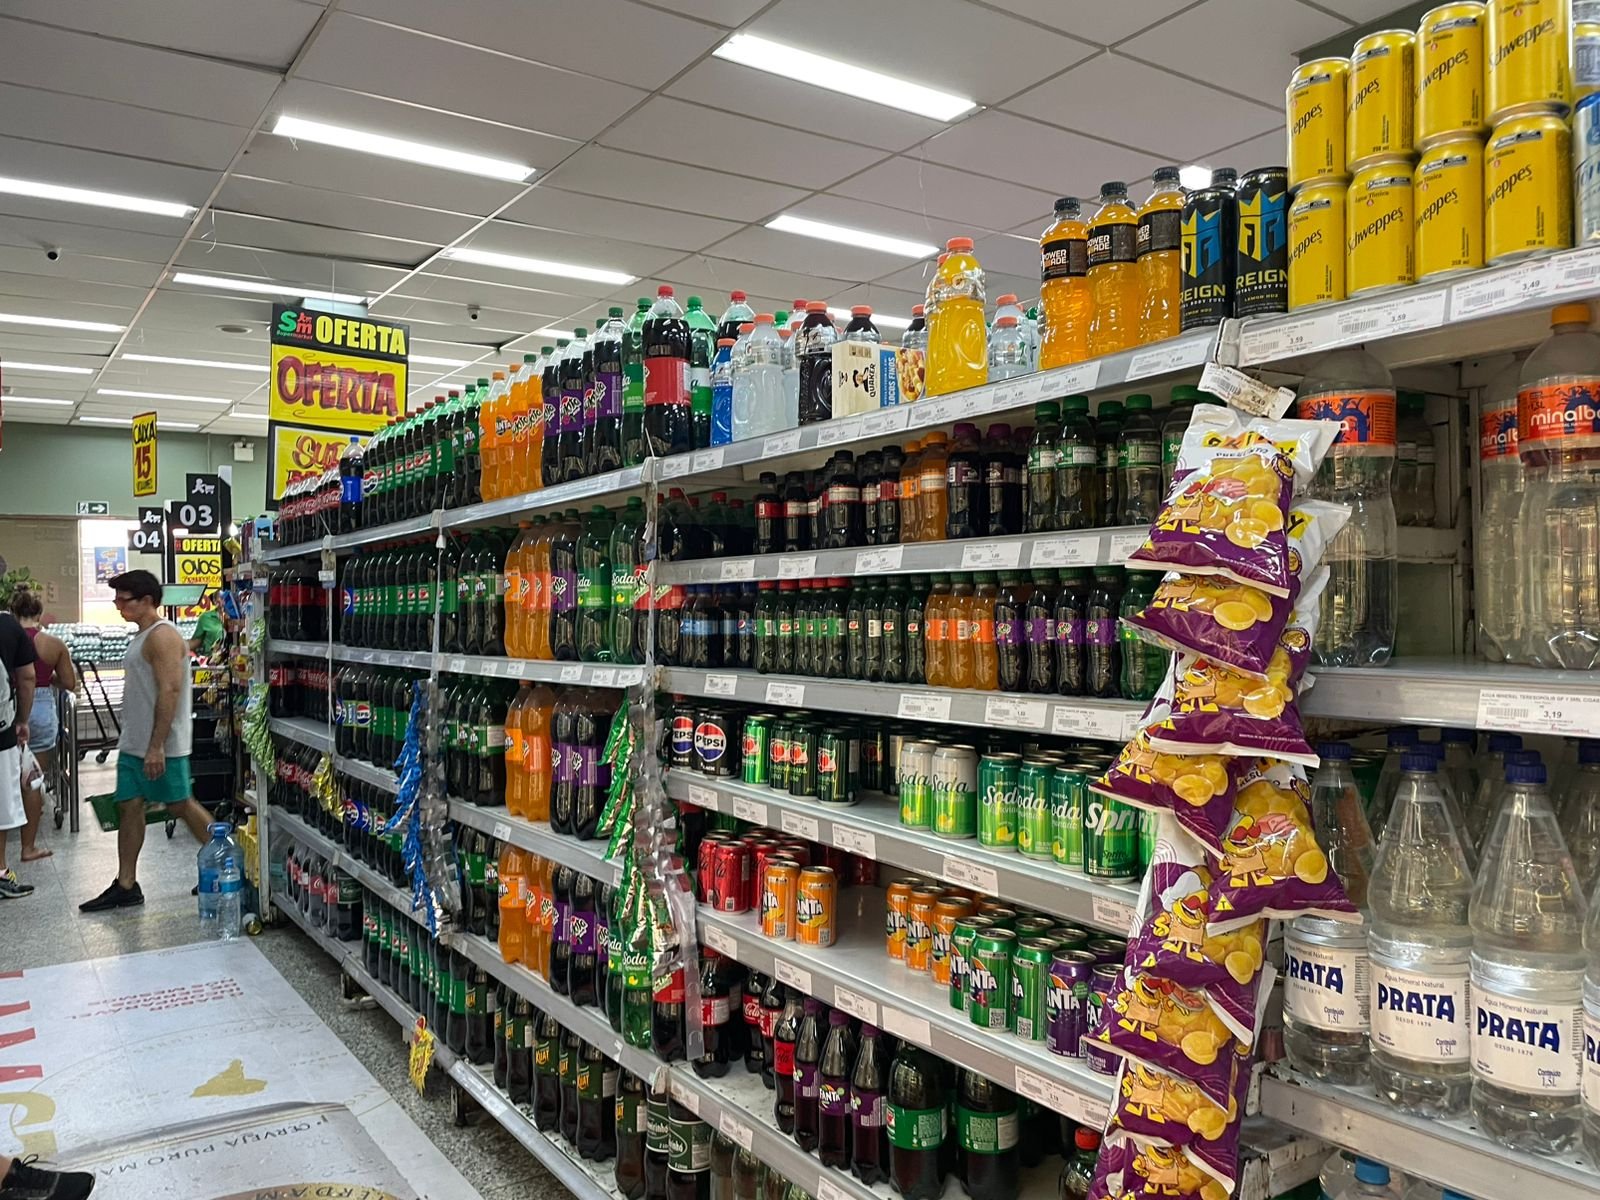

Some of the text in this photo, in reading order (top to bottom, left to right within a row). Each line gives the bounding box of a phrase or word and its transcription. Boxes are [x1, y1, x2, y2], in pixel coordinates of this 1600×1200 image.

[1291, 103, 1323, 136] eppes
[1487, 164, 1533, 209] weppes
[1415, 187, 1458, 229] weppes
[1137, 224, 1150, 236] WER
[1347, 206, 1404, 257] Schweppes
[1288, 228, 1322, 265] weppes
[1522, 279, 1540, 291] 3,49
[315, 315, 407, 356] OFERTA
[277, 355, 398, 416] OFERTA
[868, 363, 877, 398] QUAKER
[133, 421, 157, 445] CAIXA
[134, 444, 151, 480] 15
[179, 504, 213, 527] 03
[133, 531, 161, 548] 04
[182, 558, 220, 575] OVOS
[1543, 710, 1562, 719] 3,19
[672, 729, 693, 740] PEPS
[696, 734, 725, 748] PEPSI
[931, 773, 969, 794] Soda
[1018, 791, 1049, 810] oda
[1051, 801, 1082, 820] oda
[486, 868, 498, 878] NTA
[763, 889, 779, 909] NTA
[796, 898, 824, 915] ANTA
[887, 911, 908, 929] NTA
[907, 921, 931, 939] NTA
[622, 950, 648, 966] Soda
[950, 954, 970, 975] NTA
[1312, 951, 1334, 961] Natural
[970, 969, 997, 990] NTA
[1285, 952, 1344, 995] PRATA
[1399, 976, 1421, 987] Mineral
[1422, 980, 1445, 989] Natural
[1323, 1006, 1345, 1015] Conteúdo
[1377, 982, 1455, 1023] PRATA
[1499, 1000, 1523, 1012] Mineral
[1524, 1006, 1548, 1016] Natural
[1477, 1006, 1561, 1054] PRATA
[1436, 1038, 1457, 1046] Conteúdo
[535, 1049, 550, 1066] KUAT
[1537, 1068, 1561, 1077] Conteúdo
[819, 1088, 841, 1103] FANTA
[223, 1122, 312, 1149] CERVEJA
[146, 1143, 215, 1167] PURO
